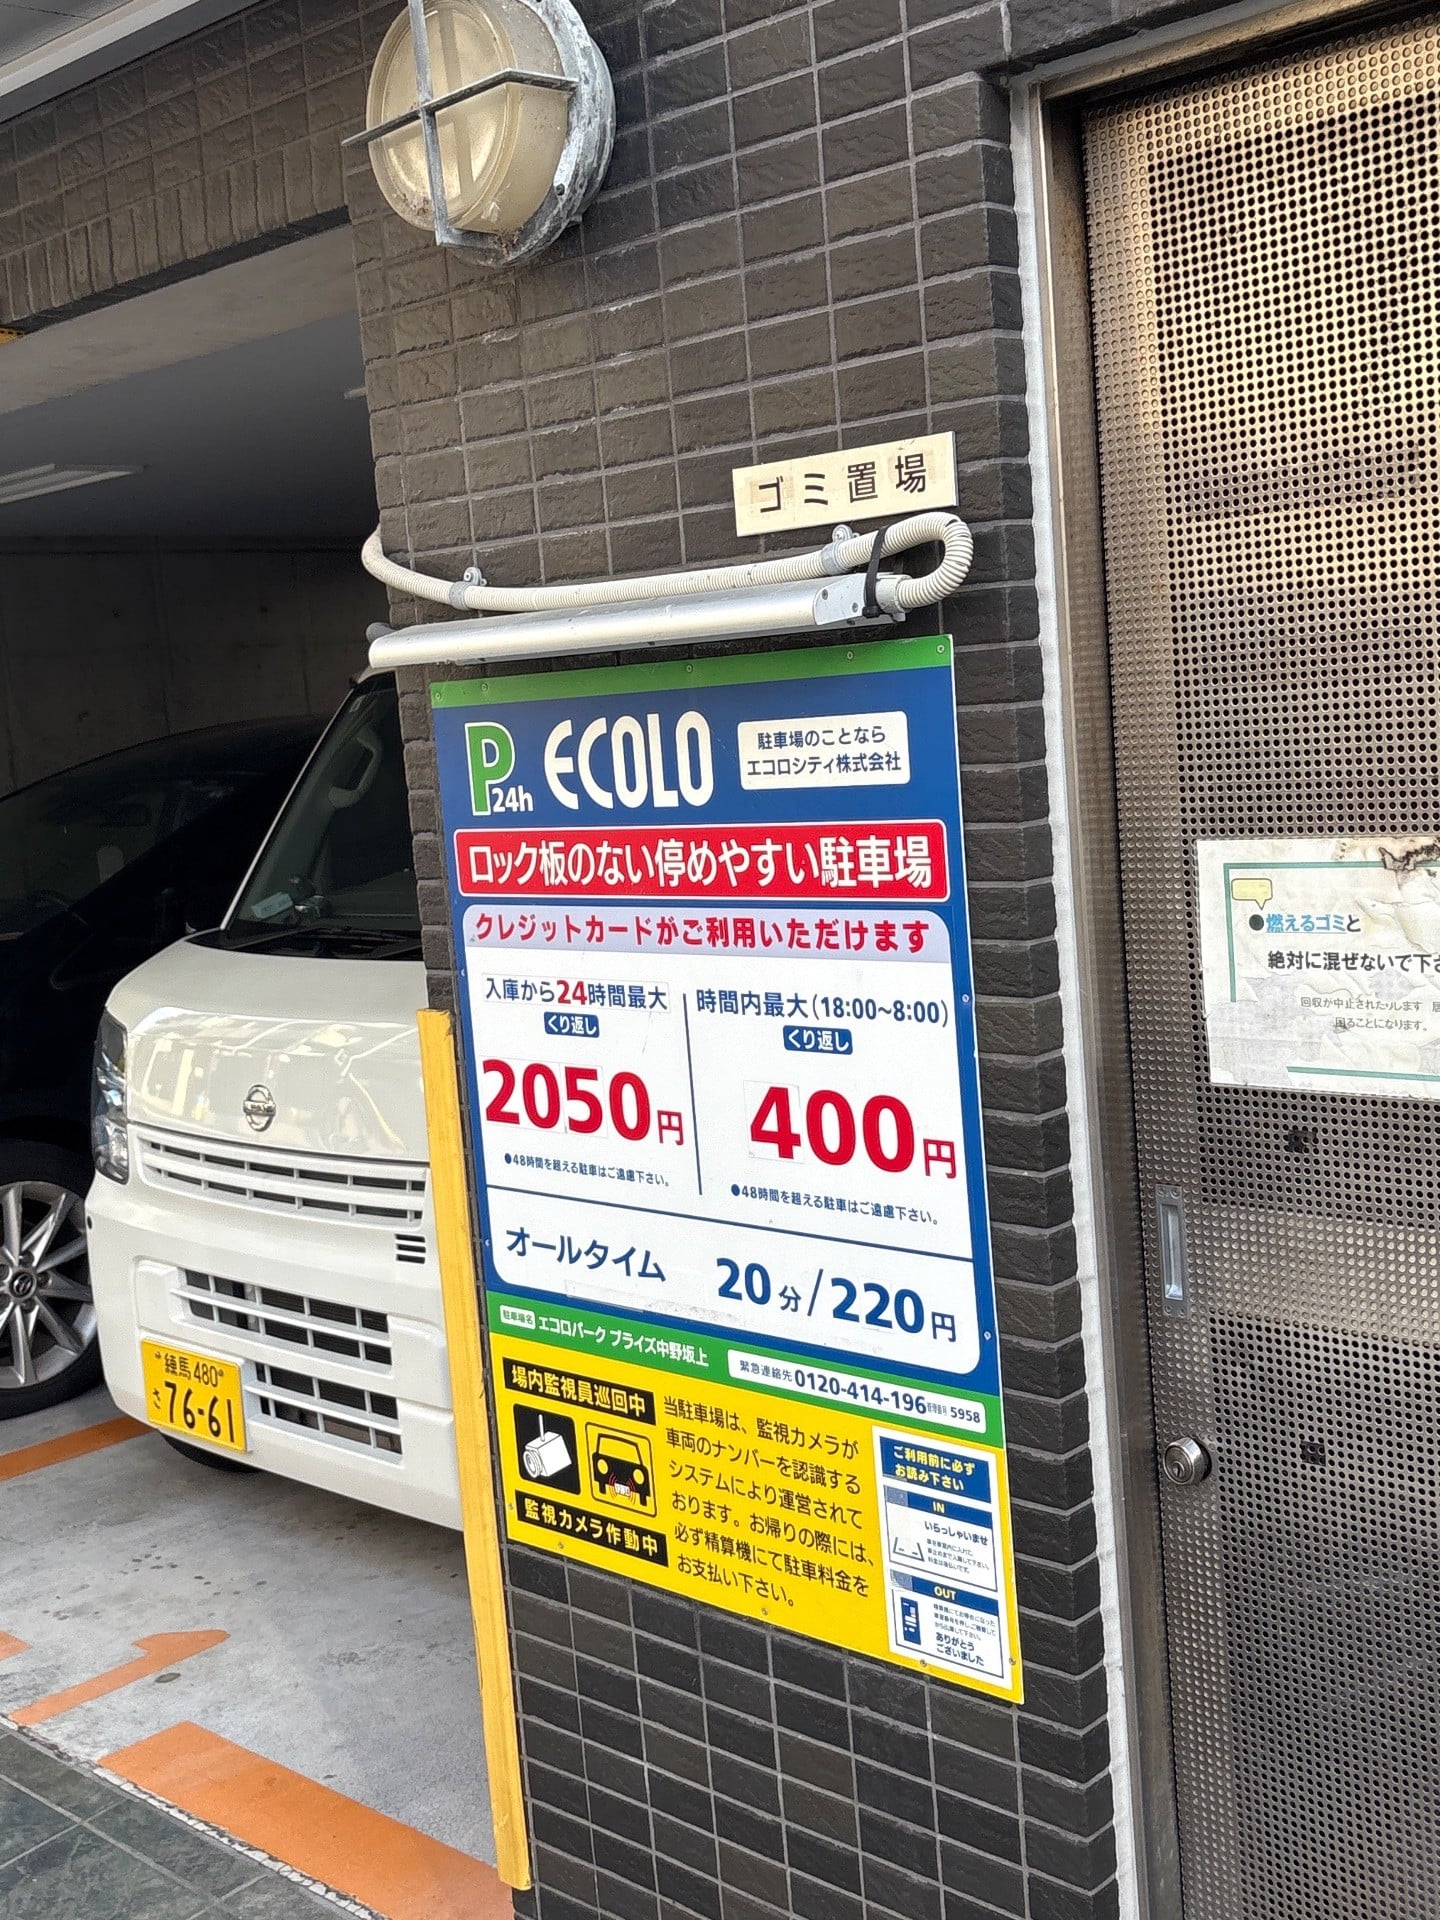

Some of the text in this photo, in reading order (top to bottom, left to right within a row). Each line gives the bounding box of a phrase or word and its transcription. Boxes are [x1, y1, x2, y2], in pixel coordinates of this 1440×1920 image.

[759, 453, 926, 513] ゴミ置場
[757, 725, 886, 751] 駐車場のことなら
[464, 721, 516, 816] P
[544, 710, 714, 810] ECOLO
[747, 752, 902, 777] エコロシティ株式会社
[491, 786, 534, 813] 24h
[469, 834, 932, 890] ロック板のない停めやすい駐車場
[475, 912, 930, 953] クレジットカードがご利用いただけます
[1266, 914, 1361, 933] 燃えるゴミと
[485, 977, 668, 1011] 入庫から24時間最大
[547, 1015, 597, 1035] くり返し
[787, 1028, 850, 1051] くり返し
[506, 1226, 666, 1282] オールタイム
[539, 1316, 606, 1343] エコロパーク
[164, 1380, 234, 1443] 76-61
[512, 1365, 645, 1417] 場内監視員巡回中
[740, 1360, 793, 1382] 緊急連絡先
[794, 1369, 927, 1414] 0120-414-196
[950, 1407, 981, 1423] 5958
[664, 1396, 859, 1460] 当駐車場は、監視カメラが
[666, 1428, 860, 1494] 車両のナンバーを認識する
[893, 1445, 975, 1476] ご利用前に必ず
[895, 1464, 964, 1491] お読み下さい
[669, 1460, 863, 1530] システムにより運営されて
[933, 1501, 945, 1513] IN
[524, 1498, 658, 1556] 監視カメラ作動中
[672, 1491, 874, 1567] おります。お帰りの際には、
[924, 1521, 988, 1546] いらっしゃいませ
[674, 1522, 869, 1597] 必ず精算機にて駐車料金を
[677, 1554, 794, 1607] お支払い下さい。
[934, 1586, 956, 1600] OUT
[936, 1632, 974, 1651] ありがとう
[937, 1643, 984, 1666] ございました
